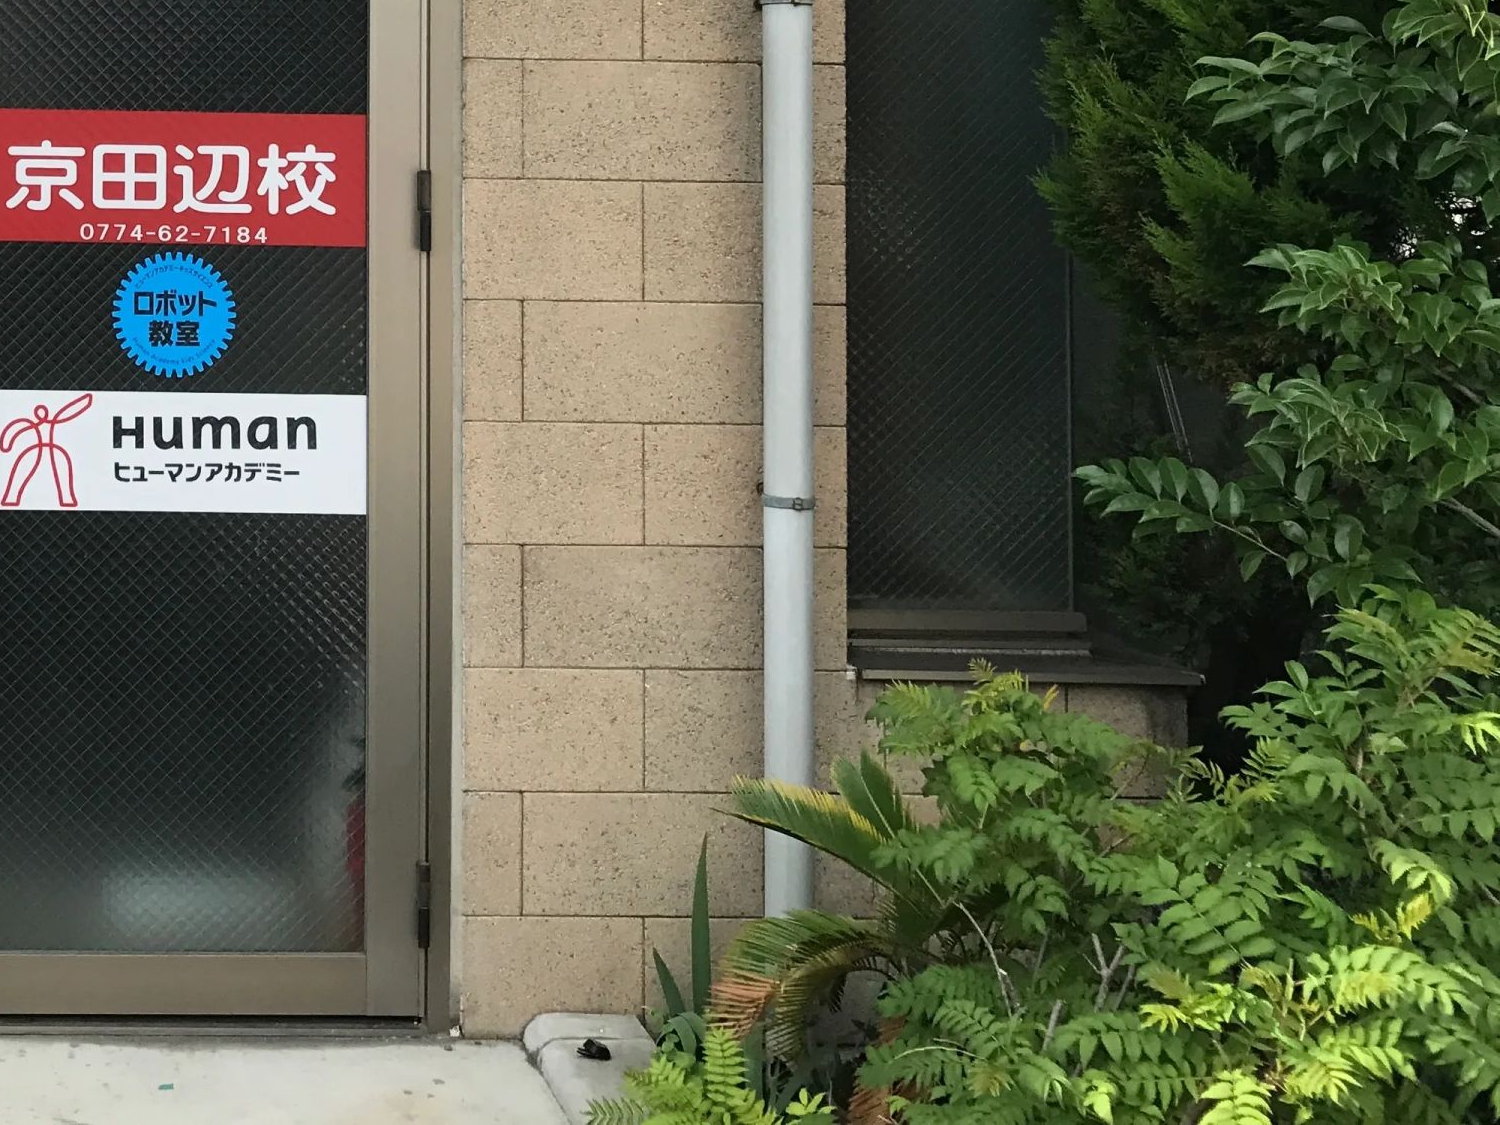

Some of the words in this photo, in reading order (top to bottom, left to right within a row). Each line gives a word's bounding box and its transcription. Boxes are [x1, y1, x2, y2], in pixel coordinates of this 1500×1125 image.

[6, 139, 337, 216] 京田辺校
[79, 223, 269, 244] 0774-62-7184
[134, 290, 217, 316] ロボット
[149, 320, 200, 347] 教室
[114, 462, 301, 484] ヒューマンアカデミー
